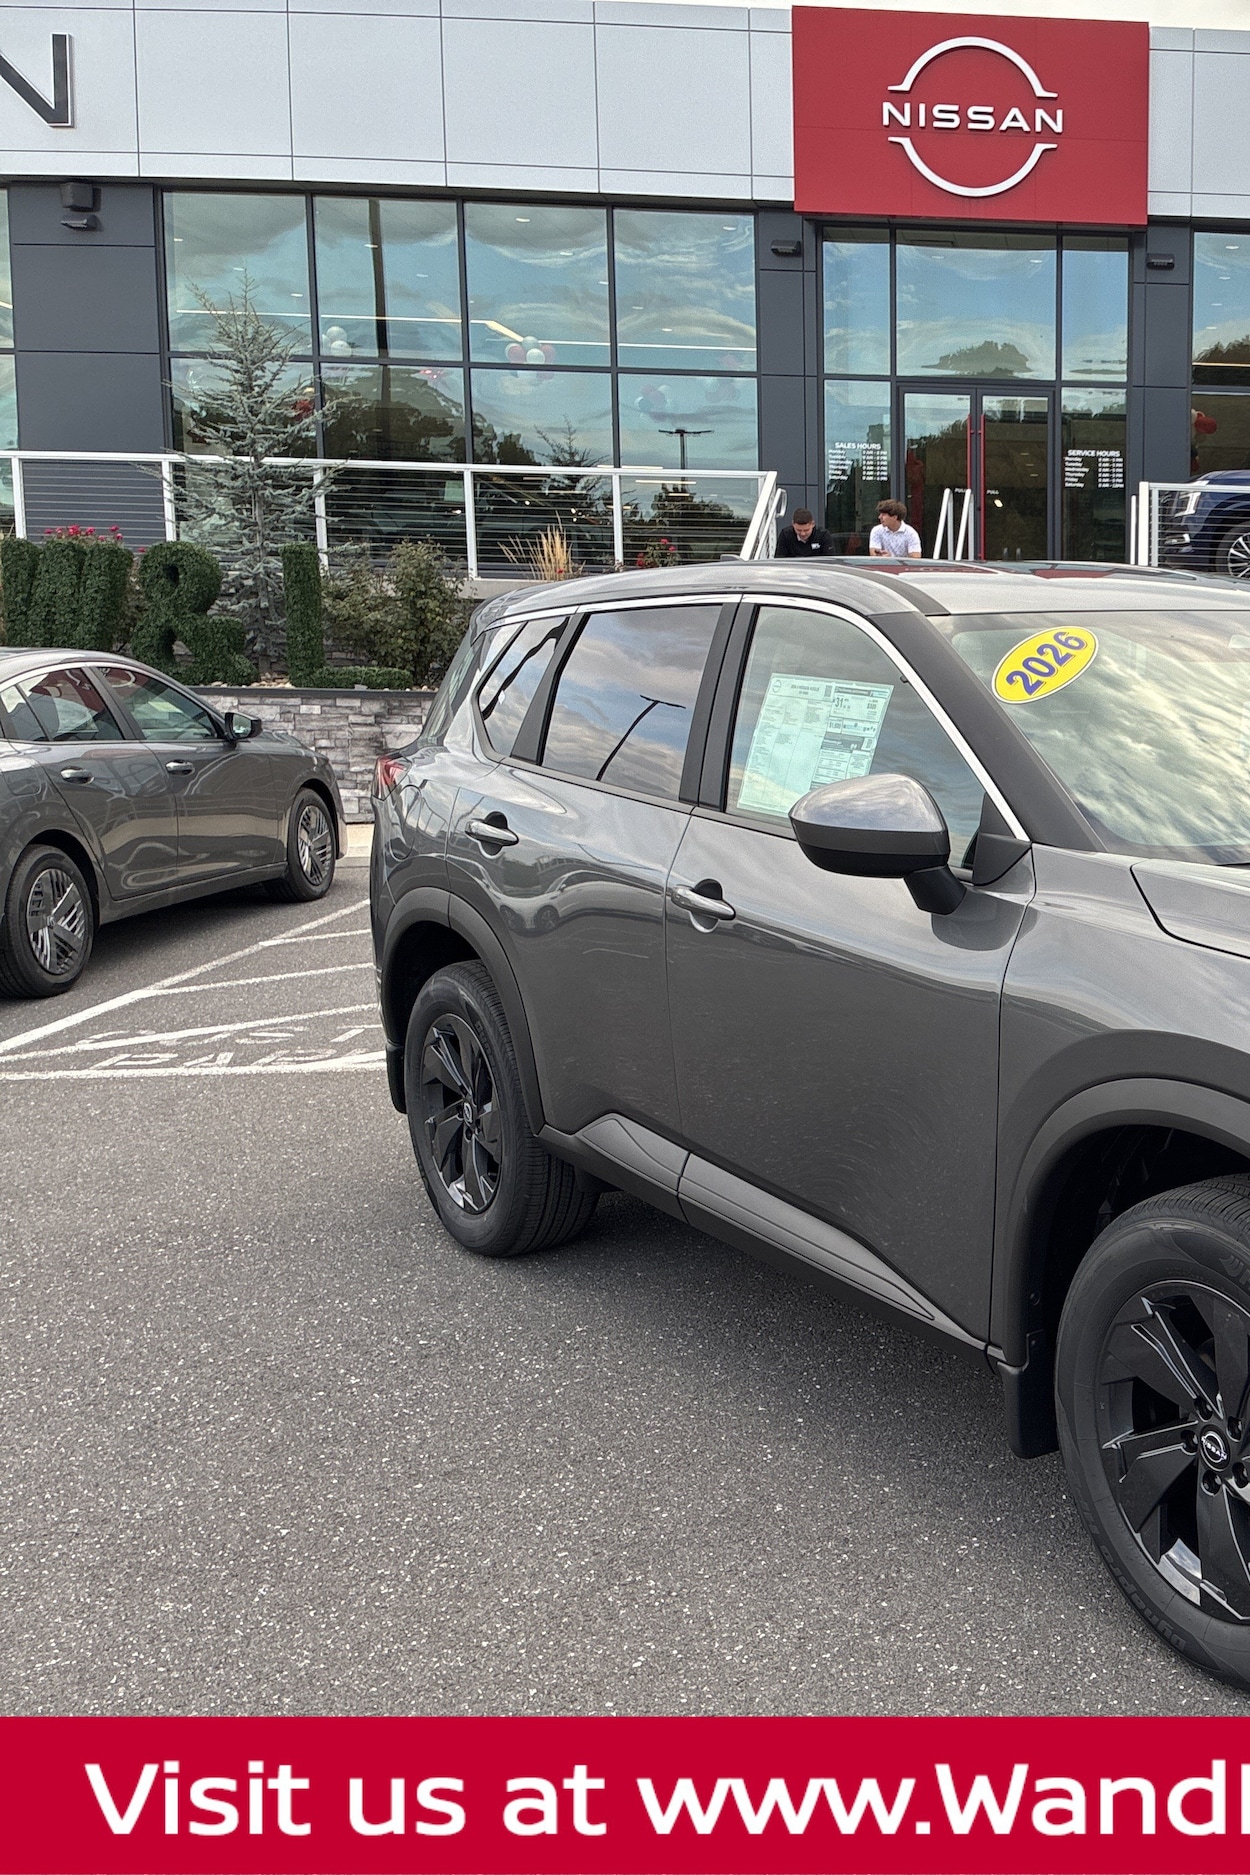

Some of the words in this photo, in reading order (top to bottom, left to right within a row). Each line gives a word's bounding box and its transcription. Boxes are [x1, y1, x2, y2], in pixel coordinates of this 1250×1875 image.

[882, 101, 1063, 134] NISSAN
[1067, 449, 1096, 457] SERVICE
[1005, 631, 1088, 696] 2026
[1100, 1544, 1187, 1653] Dynapro
